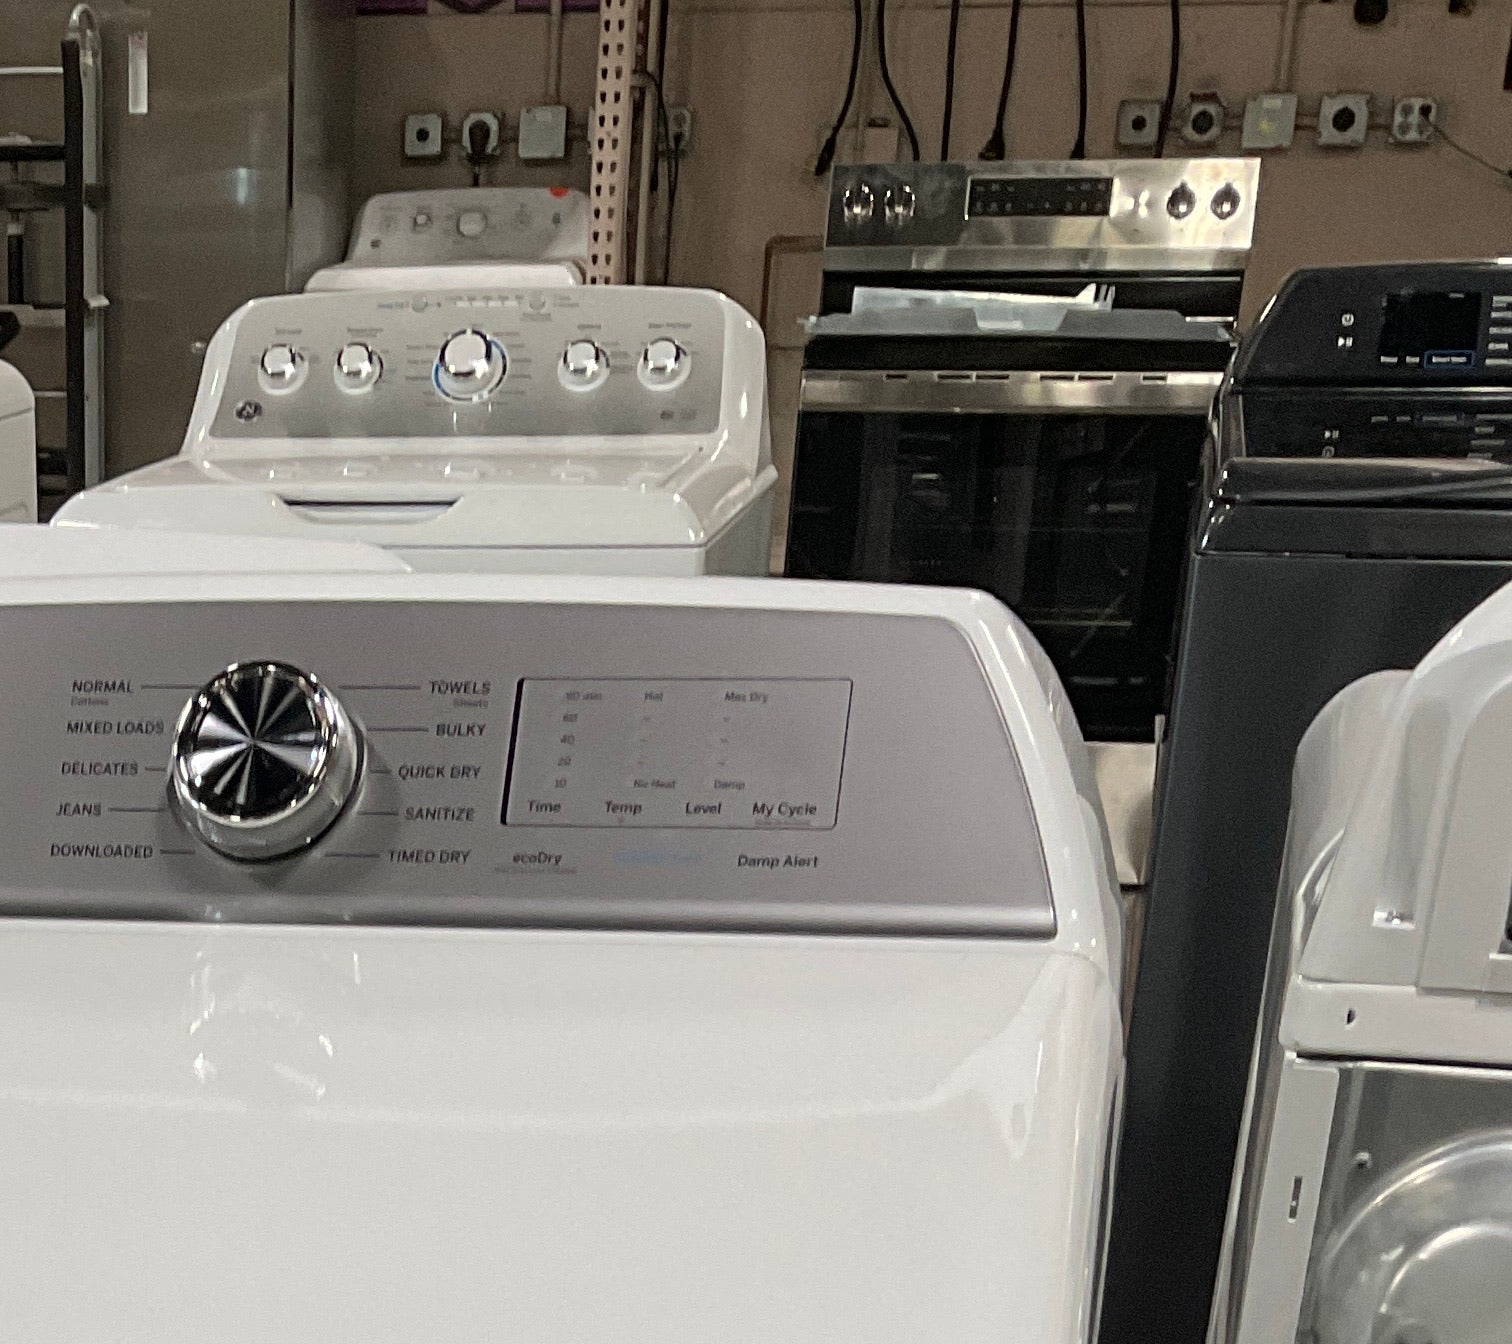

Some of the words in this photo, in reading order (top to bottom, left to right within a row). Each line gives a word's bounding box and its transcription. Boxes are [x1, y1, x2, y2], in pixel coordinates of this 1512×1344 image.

[71, 679, 134, 693] NORMAL
[429, 680, 491, 695] TOWELS
[67, 720, 113, 735] MIXED
[116, 720, 165, 735] LOADS
[436, 723, 487, 737] BULKY
[61, 761, 138, 776] DELICATES
[398, 764, 445, 780] QUICK
[450, 765, 482, 779] DRY
[55, 802, 102, 817] JEANS
[405, 806, 476, 822] SANITIZE
[528, 800, 562, 813] Time
[605, 801, 643, 816] Temp
[685, 802, 723, 816] Level
[752, 802, 774, 818] My
[777, 802, 818, 818] Cycle
[50, 843, 155, 859] DOWNLOADED
[388, 849, 436, 864] TIMED
[439, 850, 472, 865] DRY
[512, 851, 563, 866] ecoDry
[737, 854, 780, 869] Damp
[783, 854, 819, 868] Alert
